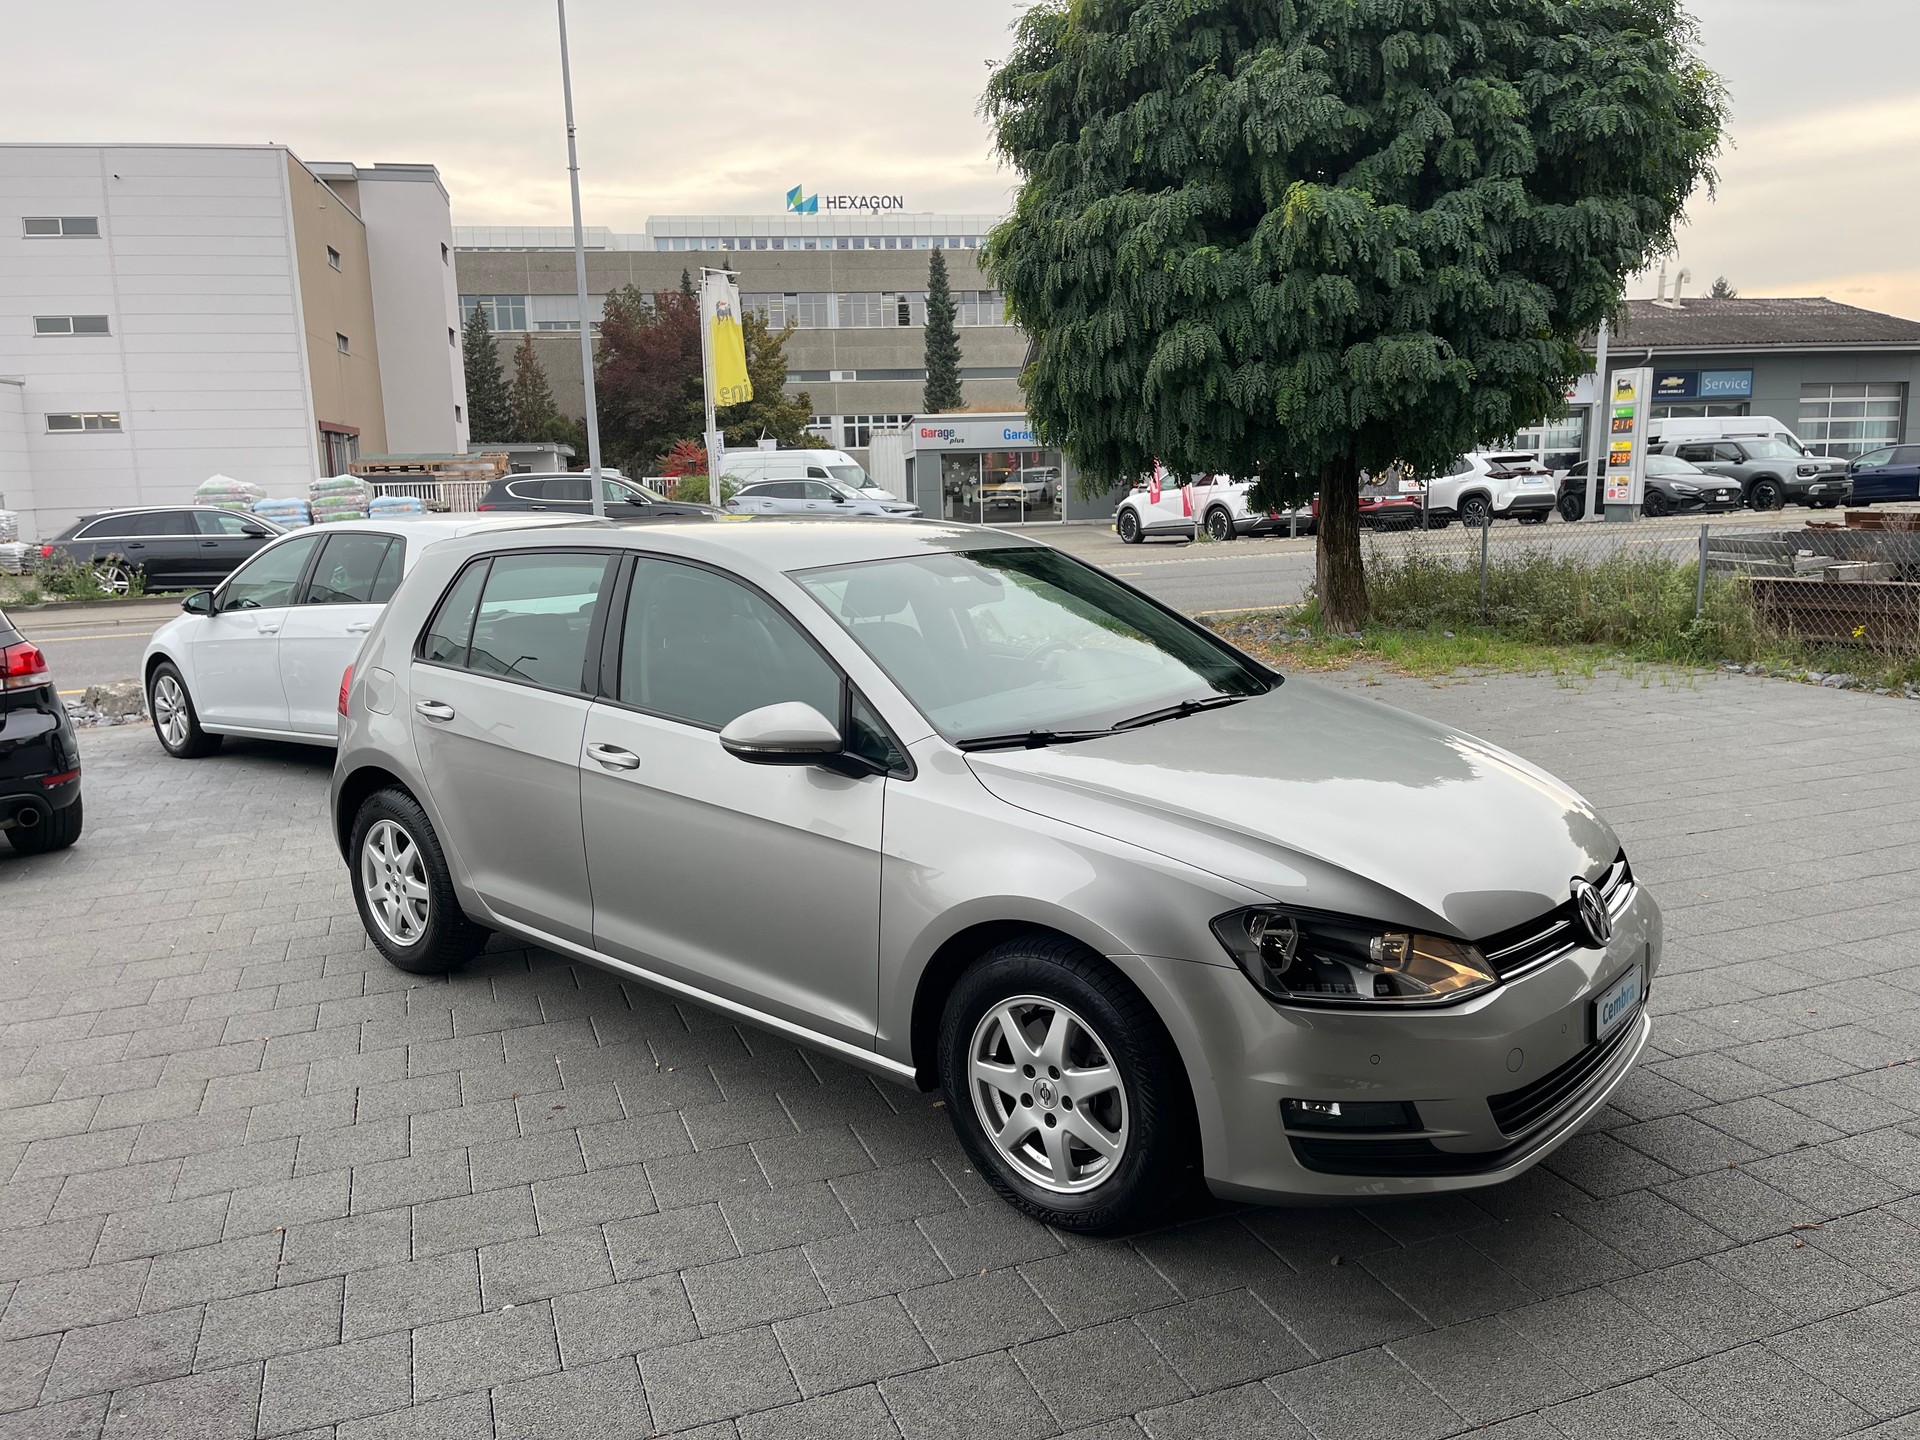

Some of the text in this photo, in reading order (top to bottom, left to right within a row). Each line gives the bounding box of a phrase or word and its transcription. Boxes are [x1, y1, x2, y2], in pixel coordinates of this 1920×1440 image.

[826, 195, 903, 209] HEXAGON
[1705, 377, 1748, 390] Service
[719, 378, 750, 406] eni
[921, 428, 955, 440] Garage
[949, 436, 965, 445] plus
[1004, 428, 1036, 441] Garag
[1602, 983, 1635, 1026] Cembra
